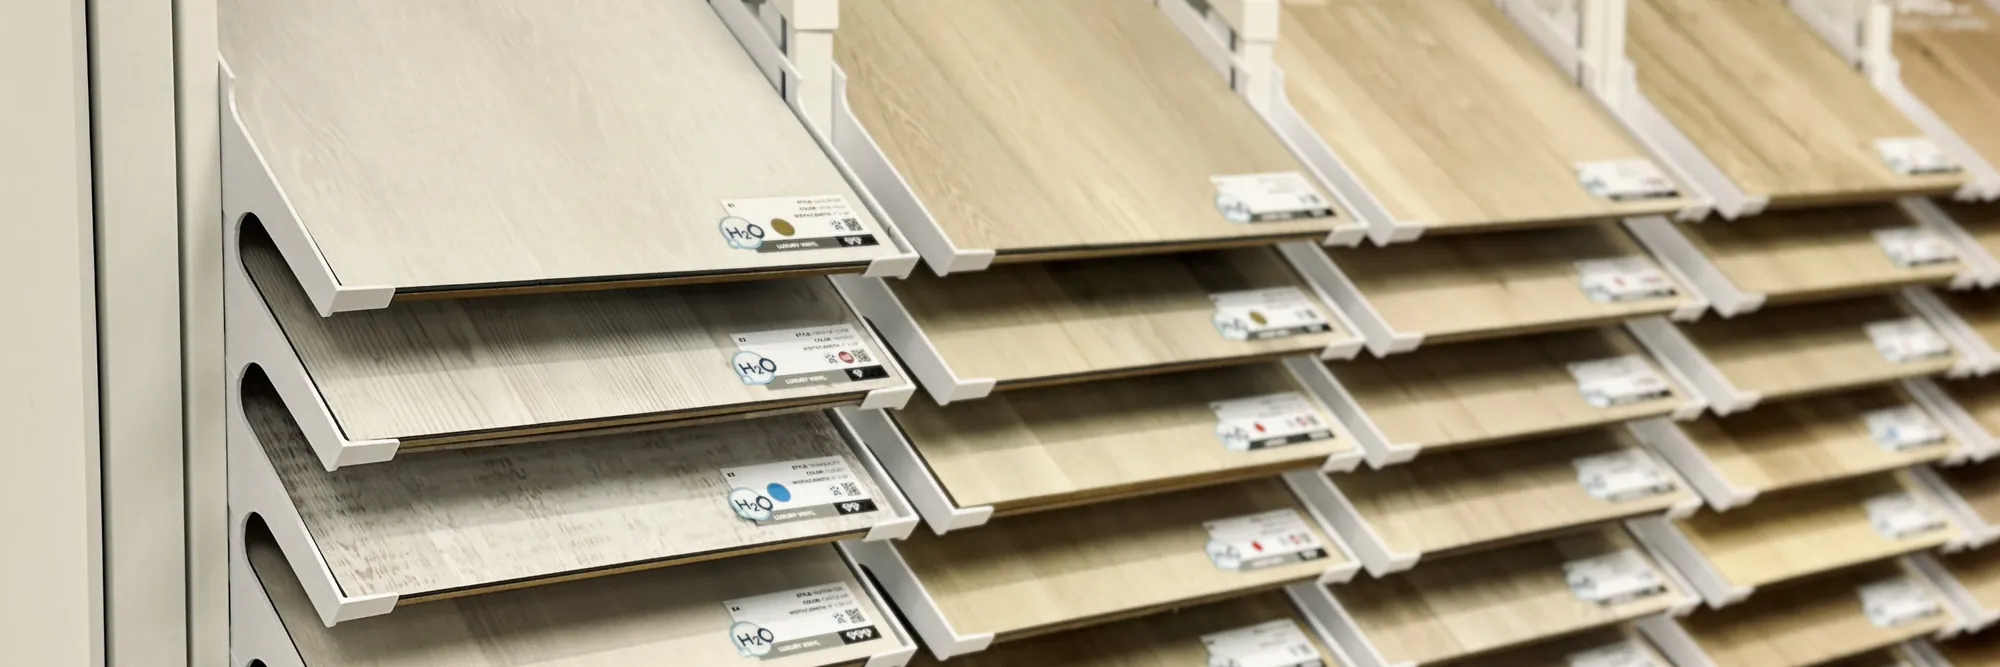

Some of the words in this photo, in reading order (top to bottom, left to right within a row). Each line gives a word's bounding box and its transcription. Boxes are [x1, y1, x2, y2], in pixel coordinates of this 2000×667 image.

[785, 377, 808, 385] LUXURY
[778, 643, 802, 652] LUXURY
[802, 640, 821, 648] VINYL
